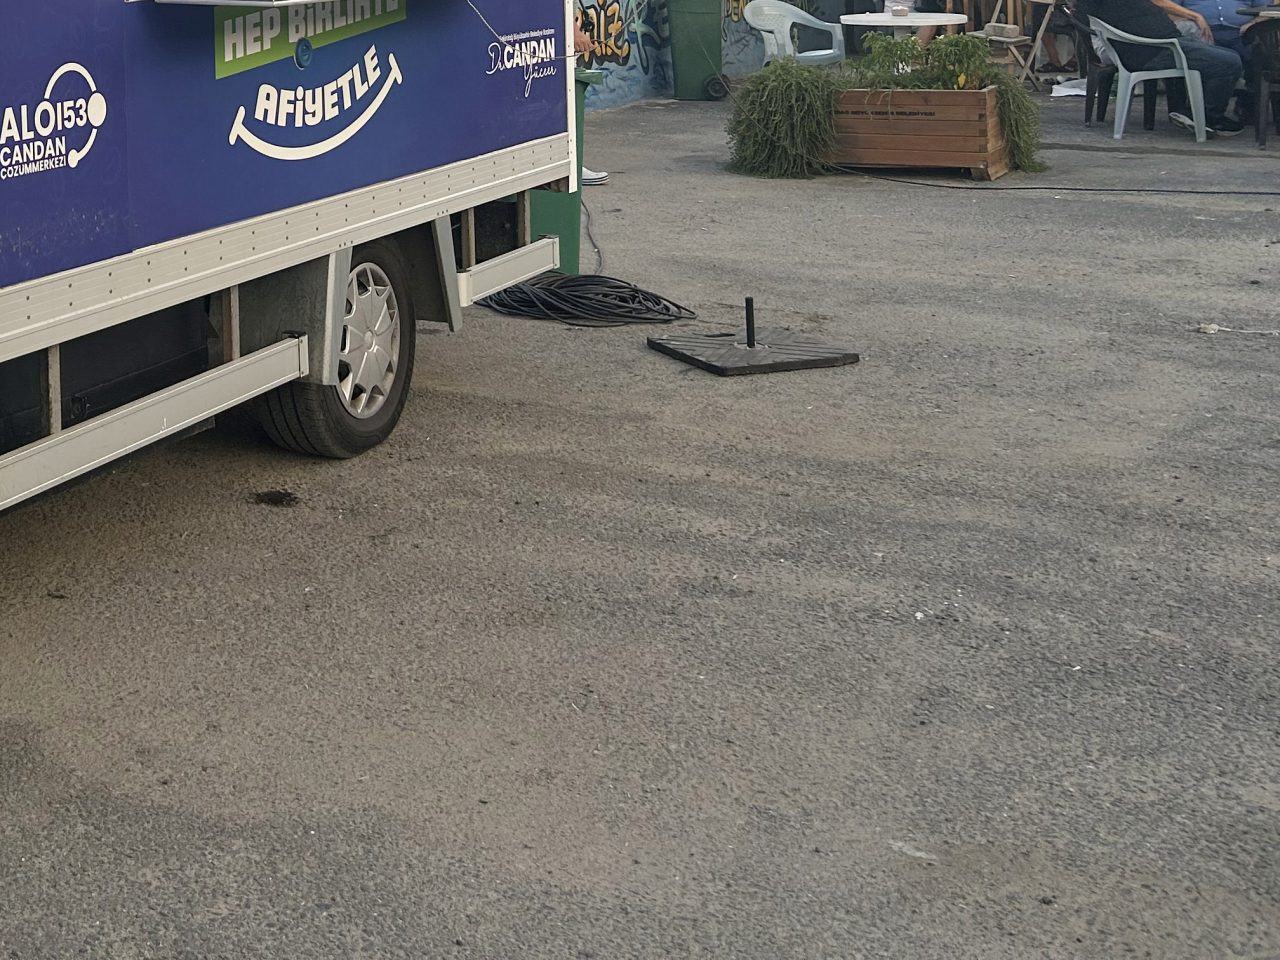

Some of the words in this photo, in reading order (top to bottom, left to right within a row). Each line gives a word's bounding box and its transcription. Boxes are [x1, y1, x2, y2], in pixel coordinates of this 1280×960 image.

[223, 6, 282, 62] HEP
[503, 37, 556, 70] CANDAN
[0, 135, 66, 167] CANDAN
